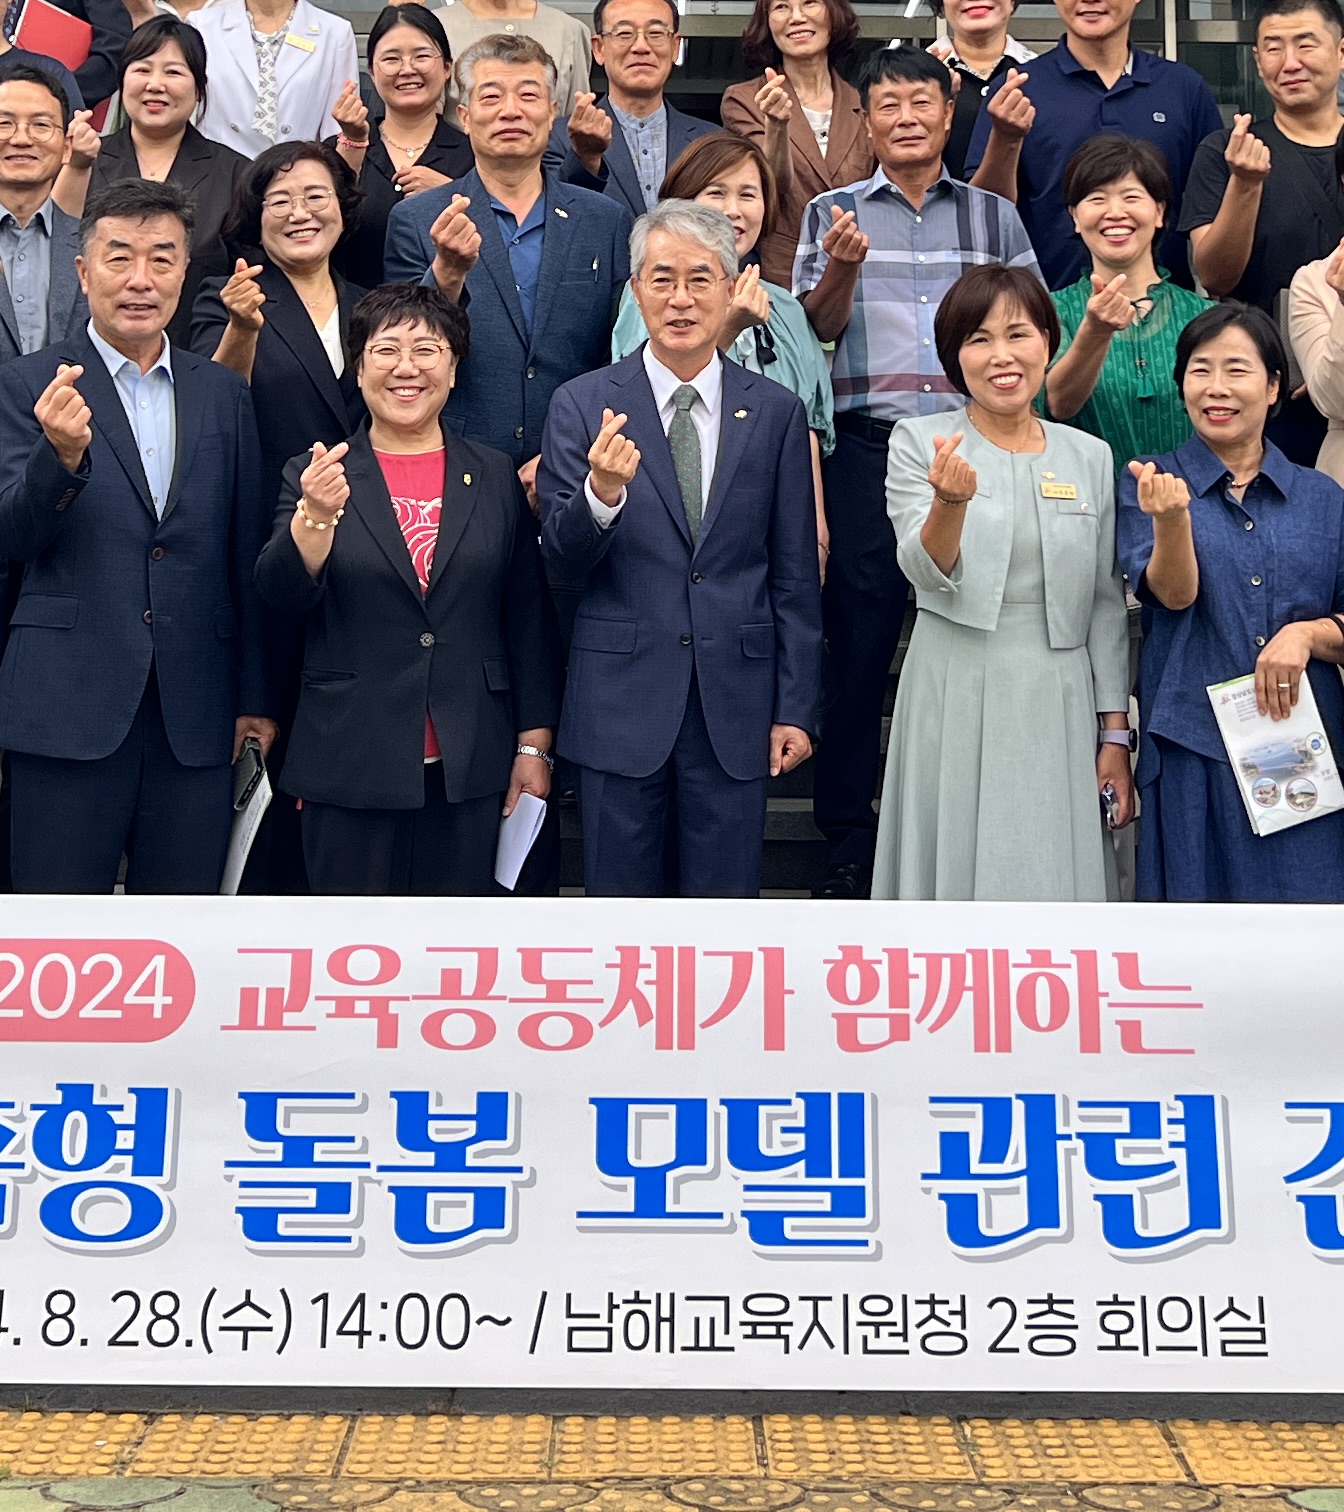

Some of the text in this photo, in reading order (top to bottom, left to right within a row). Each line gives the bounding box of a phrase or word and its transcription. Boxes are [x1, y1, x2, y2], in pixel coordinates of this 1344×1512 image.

[221, 944, 795, 1052] 교육공동체가
[823, 945, 1204, 1055] 함께하는
[223, 1089, 526, 1246] 돌봄
[575, 1091, 870, 1248] 모델
[920, 1092, 1223, 1250] 관련
[40, 1288, 89, 1348] 8.
[309, 1290, 512, 1351] 14:00~
[564, 1290, 969, 1357] 남해교육지원청
[985, 1292, 1080, 1358] 2층
[1095, 1293, 1270, 1358] 회의실
